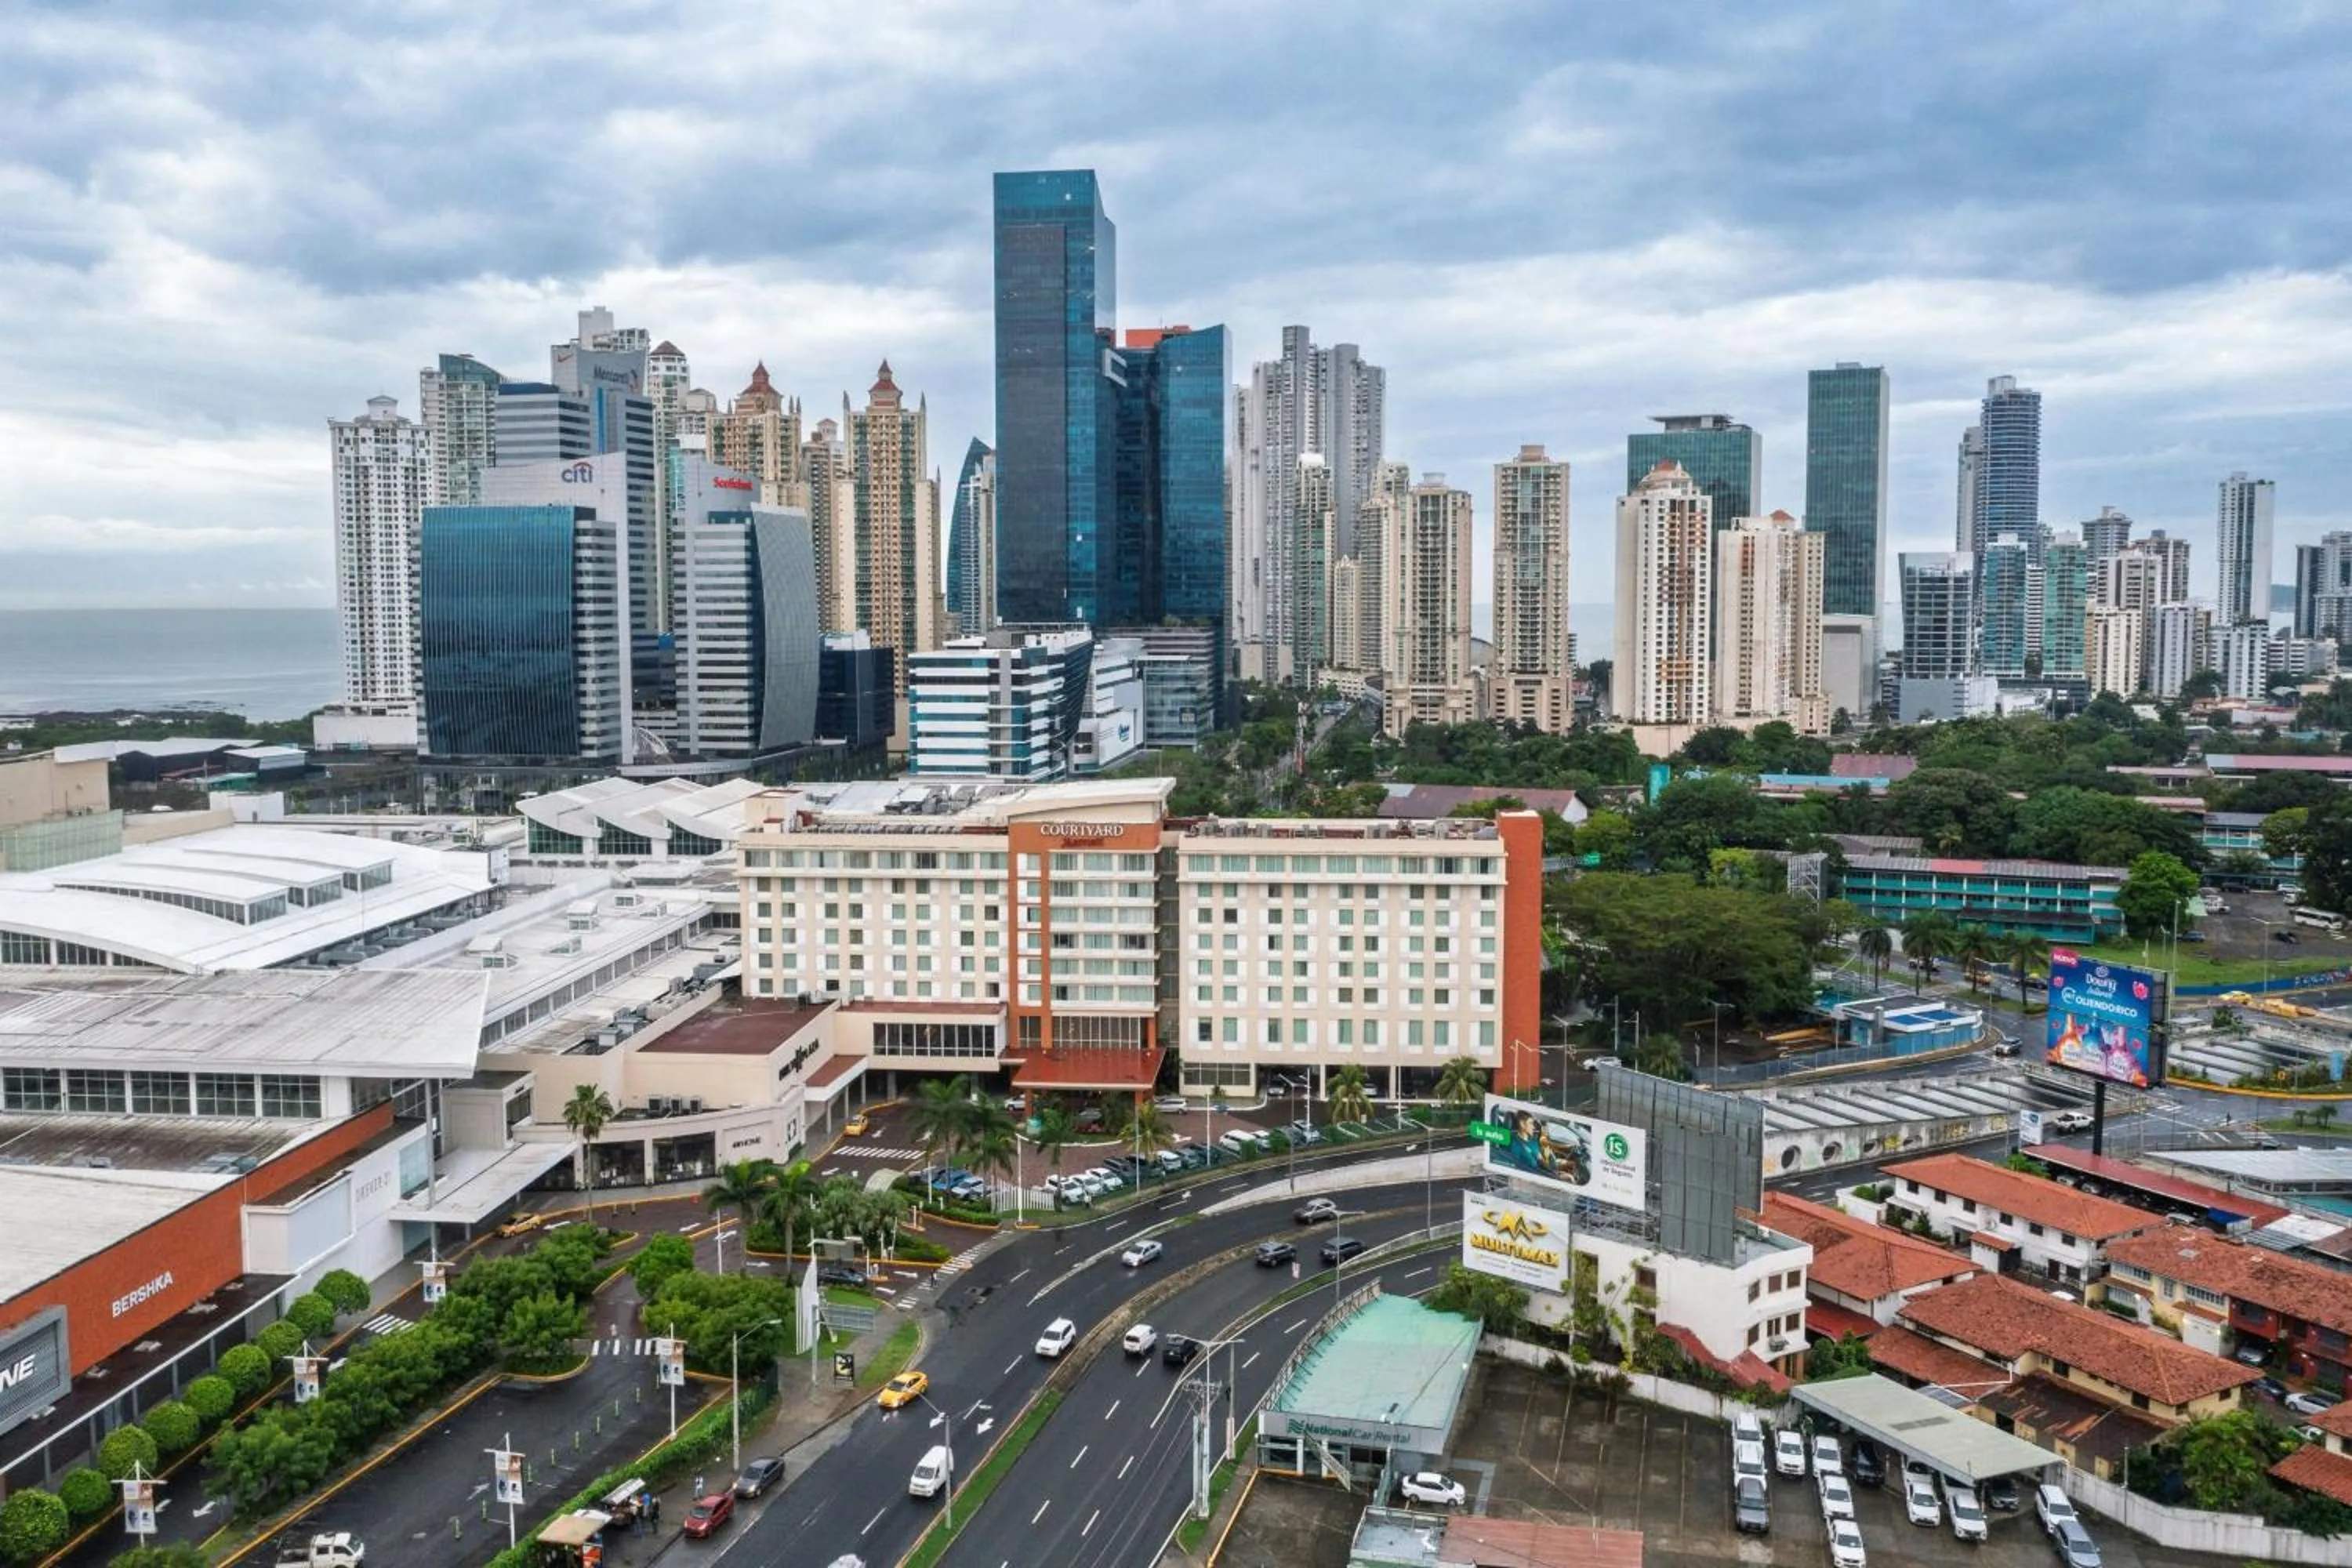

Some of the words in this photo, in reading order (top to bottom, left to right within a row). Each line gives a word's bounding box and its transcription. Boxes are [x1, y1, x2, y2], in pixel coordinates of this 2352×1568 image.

[561, 463, 593, 483] citi
[1040, 824, 1123, 837] COURTYARD
[2085, 974, 2117, 993] Downy
[1609, 1136, 1623, 1156] is
[1470, 1232, 1559, 1268] MULTIMAX
[112, 1270, 173, 1318] BERSHKA
[1305, 1422, 1352, 1437] National
[1352, 1428, 1371, 1440] Car
[1374, 1430, 1411, 1443] Rental
